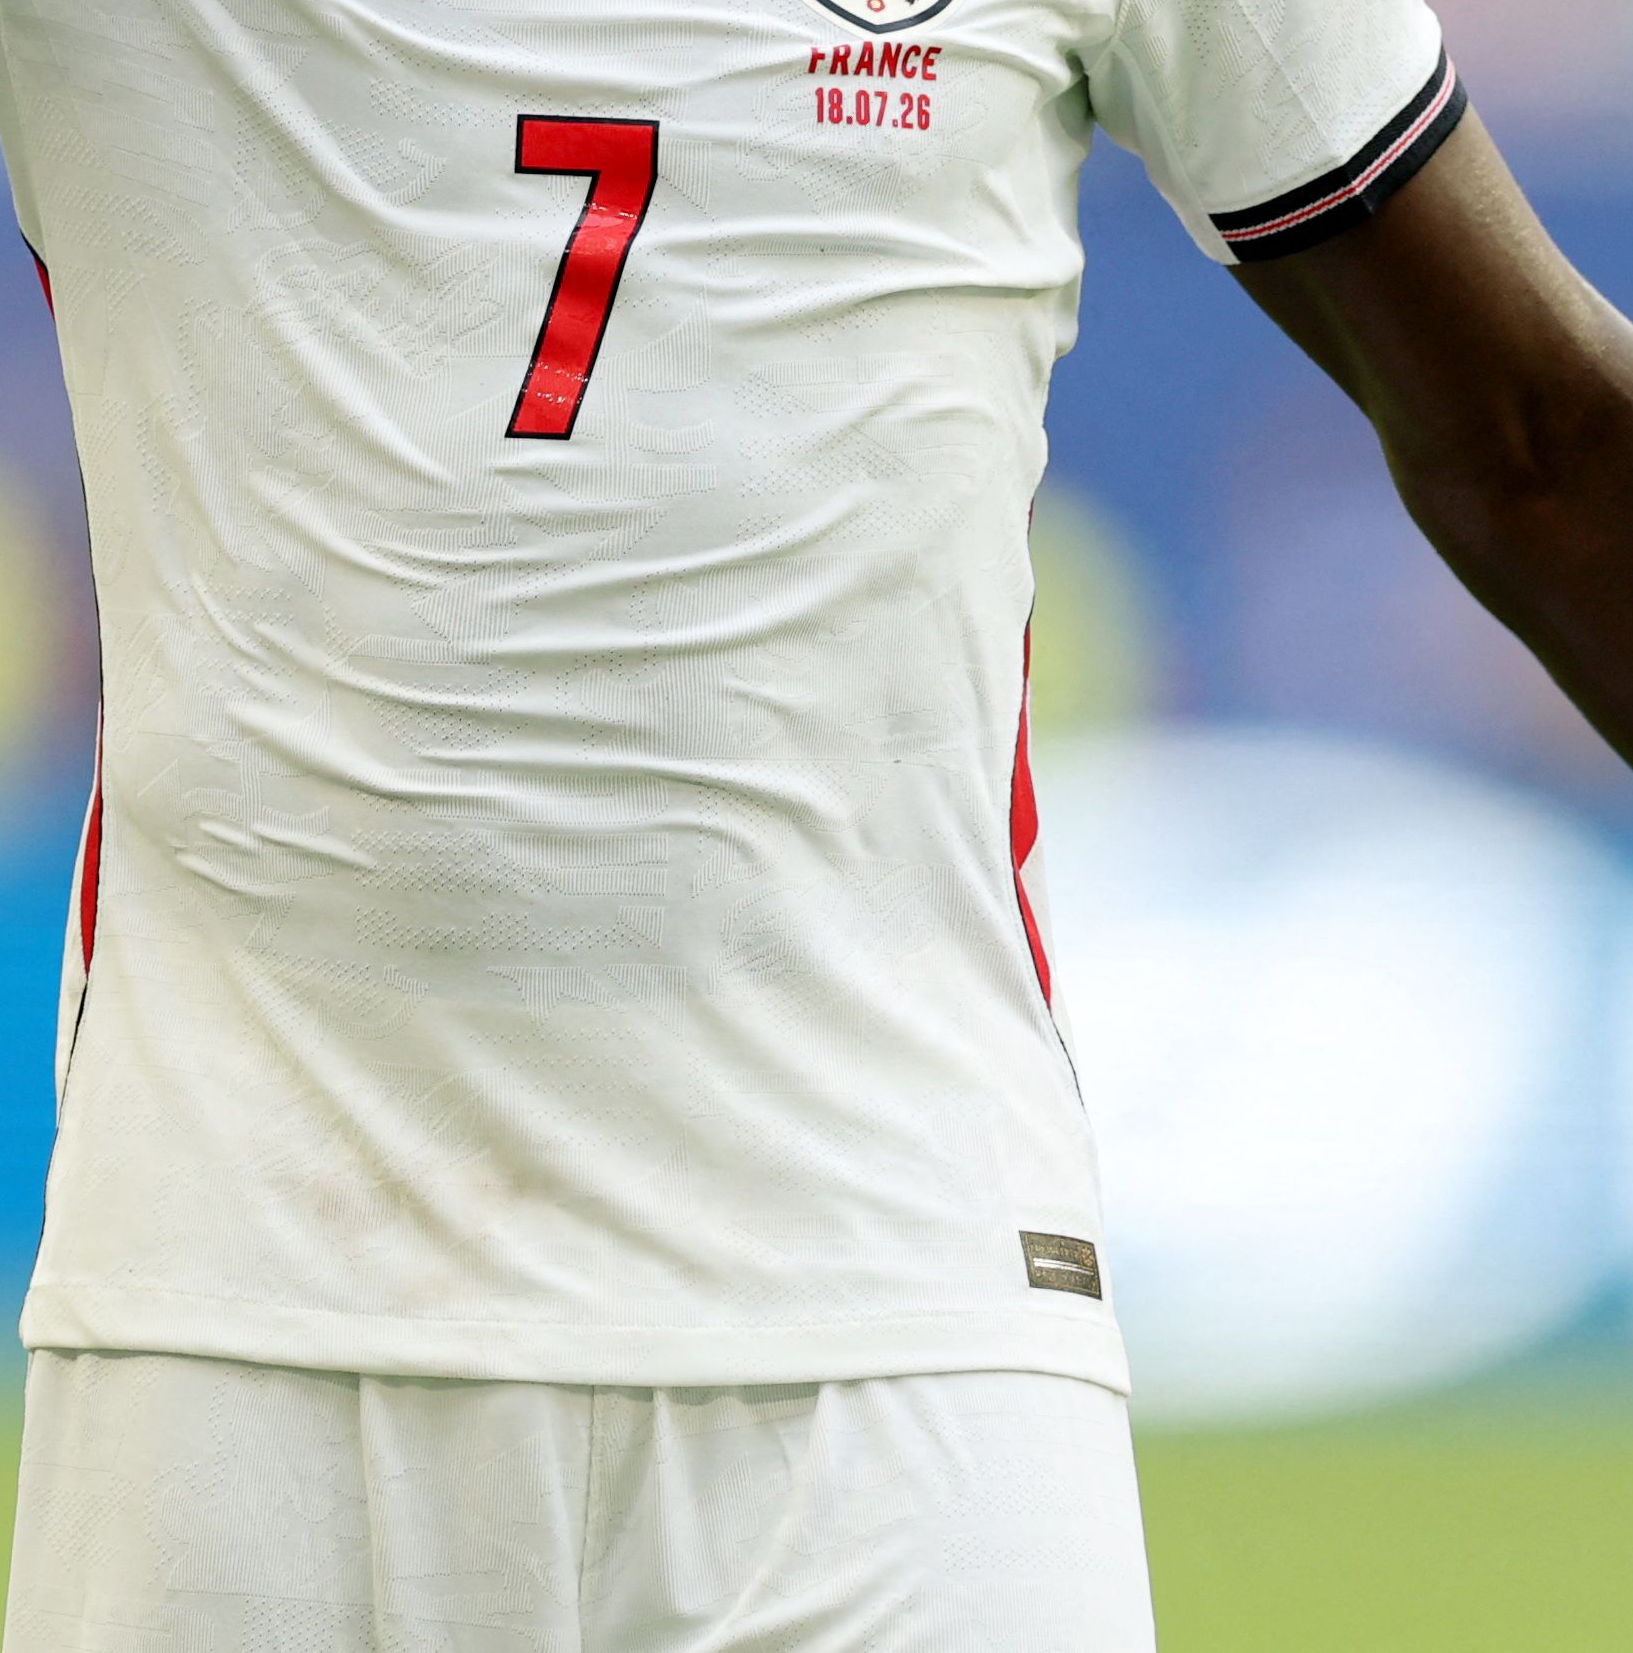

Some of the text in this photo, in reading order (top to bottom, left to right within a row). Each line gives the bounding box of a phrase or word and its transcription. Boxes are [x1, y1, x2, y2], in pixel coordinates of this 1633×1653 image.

[808, 41, 943, 81] FRANCE
[815, 86, 931, 131] 18.07.26
[505, 114, 660, 440] 7
